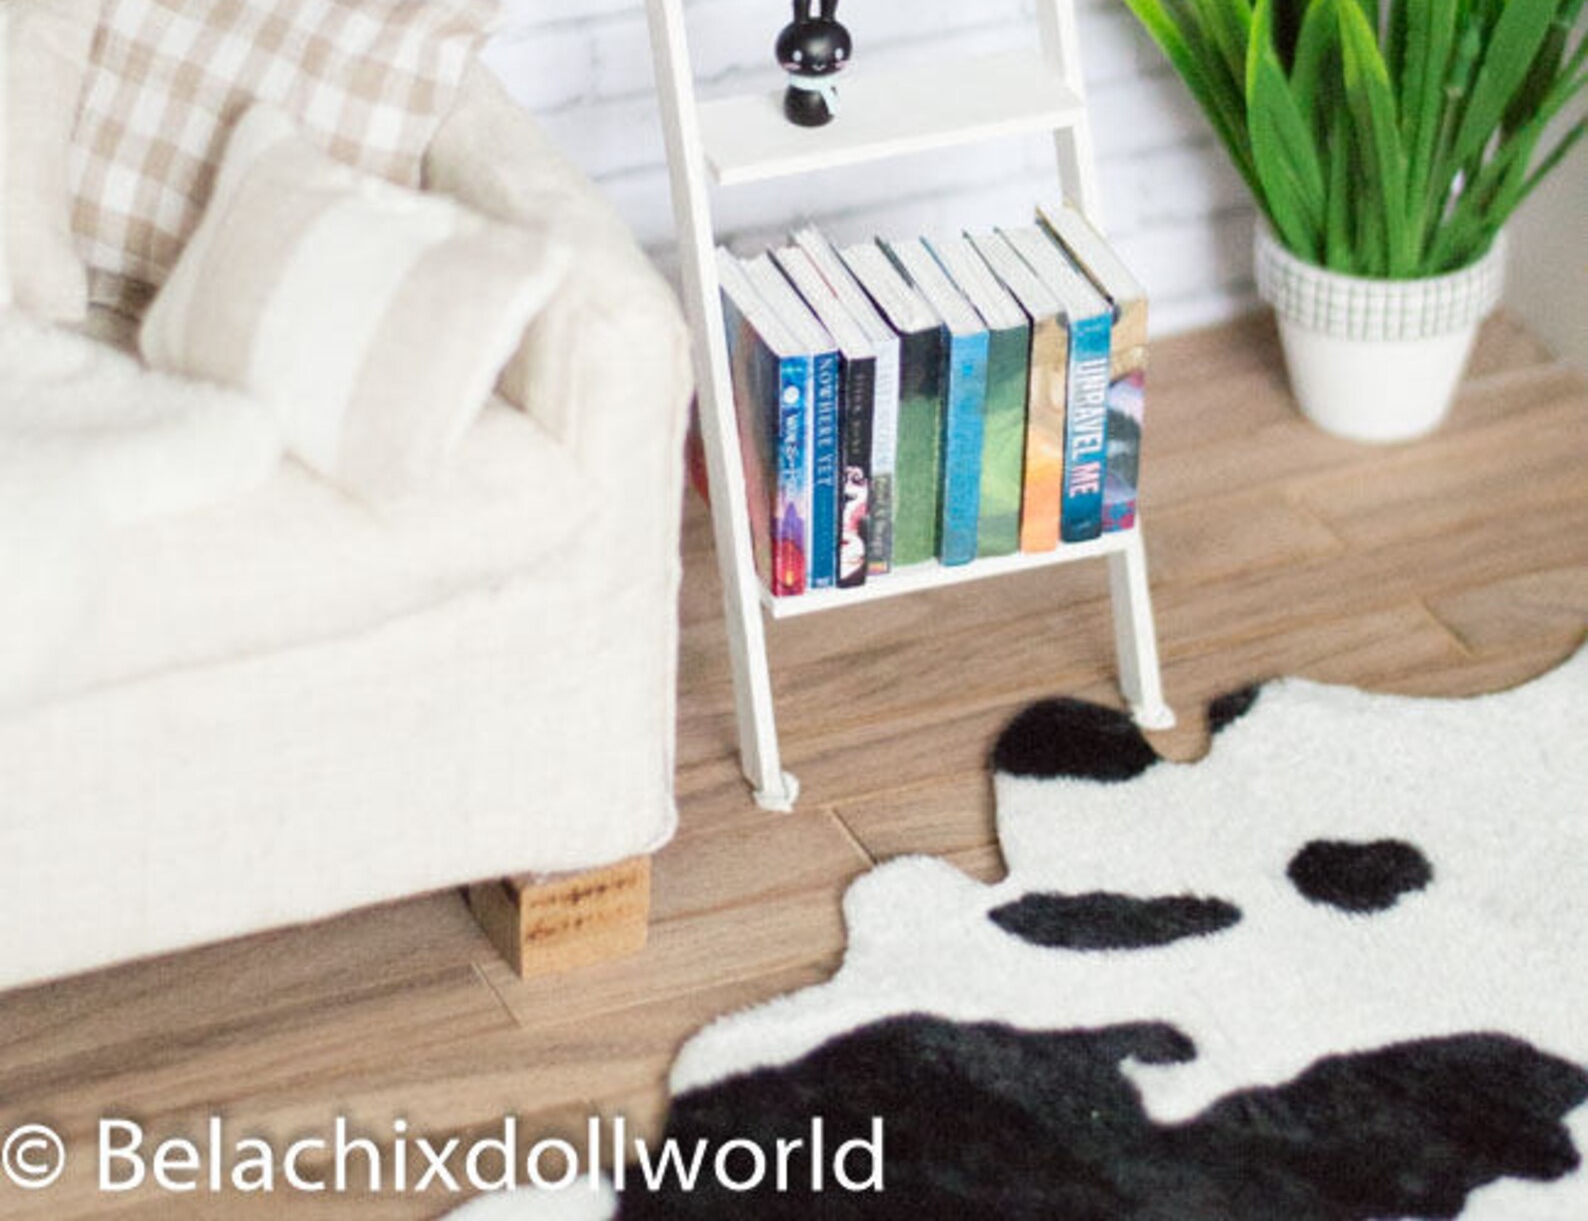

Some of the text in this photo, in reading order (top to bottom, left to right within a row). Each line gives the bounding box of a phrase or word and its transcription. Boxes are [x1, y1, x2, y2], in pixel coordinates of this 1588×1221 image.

[815, 357, 834, 487] NOWHERE YET
[1071, 358, 1108, 462] UNRAVEL
[1069, 460, 1101, 498] ME
